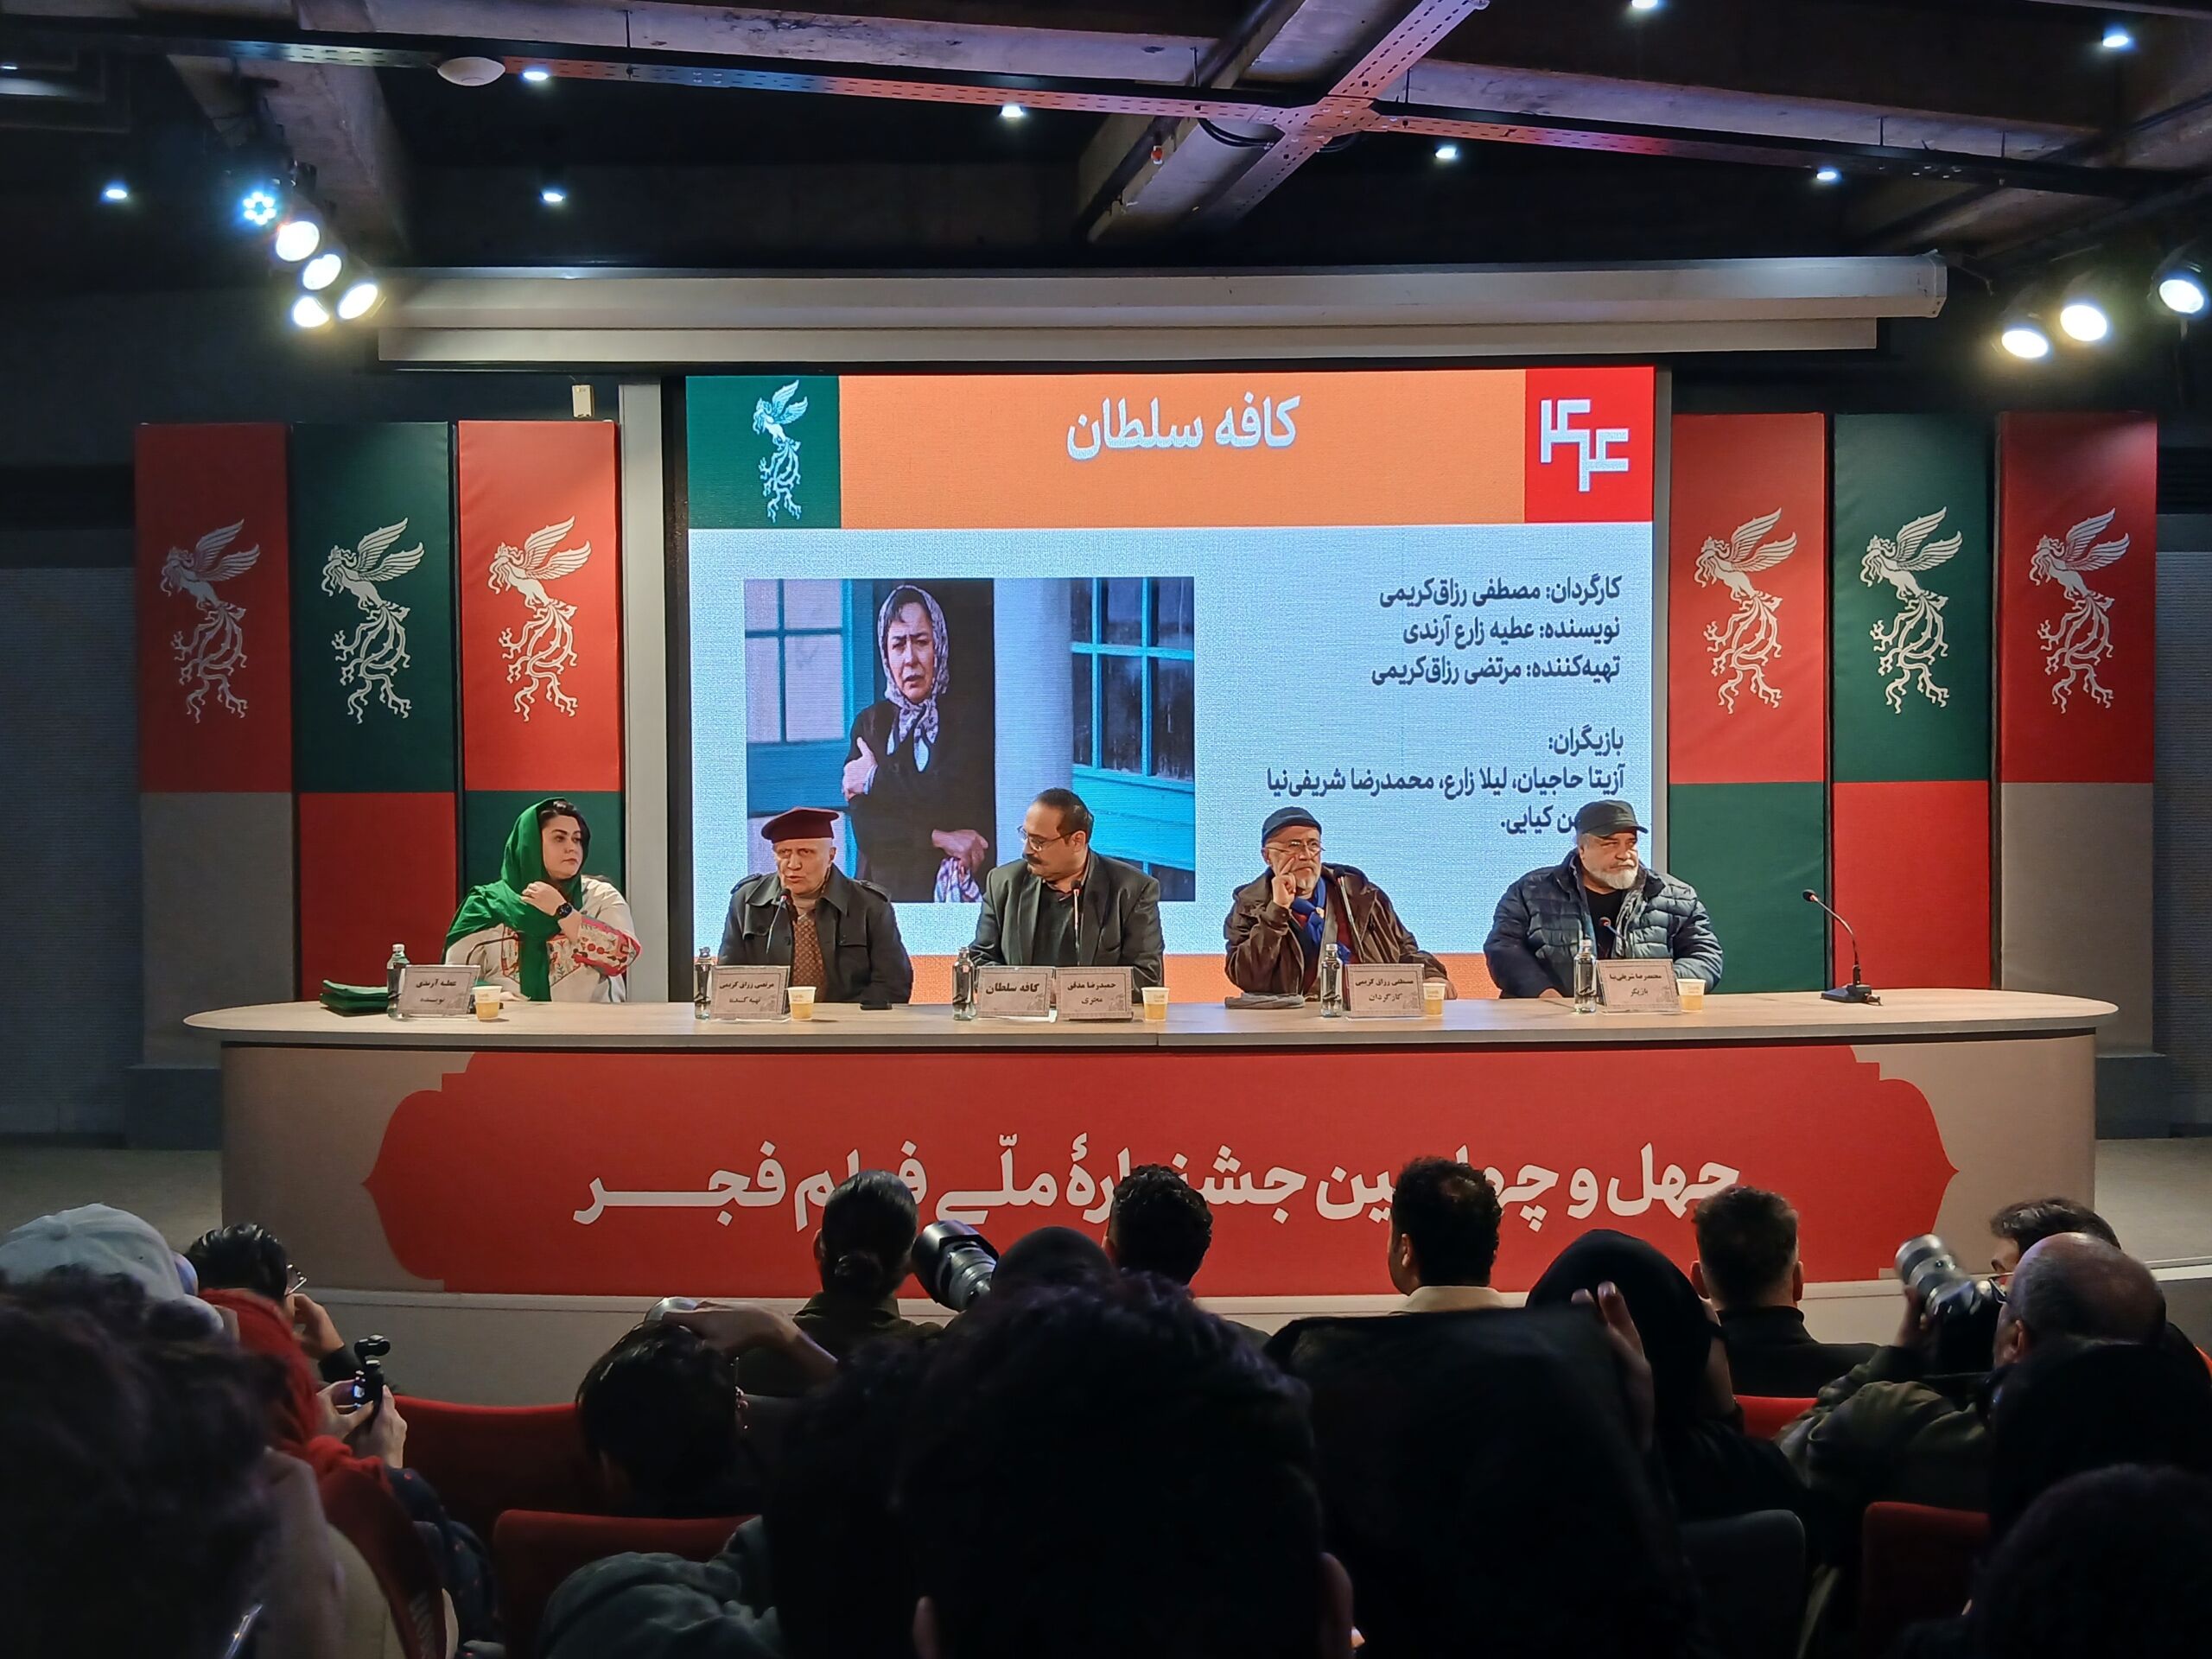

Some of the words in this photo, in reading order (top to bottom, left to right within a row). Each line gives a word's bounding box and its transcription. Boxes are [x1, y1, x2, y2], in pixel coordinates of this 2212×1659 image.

[1066, 397, 1205, 462] سلطان
[1214, 391, 1301, 450] کافه
[1472, 576, 1541, 607] مصطفی
[1546, 573, 1623, 607] کارگردان:
[1403, 613, 1452, 647] آرندی
[1454, 616, 1485, 650] زارع
[1490, 615, 1535, 645] عطیه
[1539, 616, 1620, 645] نویسنده:
[1464, 656, 1522, 685] مرتضی
[1548, 724, 1624, 757] بازیگران:
[1351, 767, 1434, 798] محمدرضا
[1439, 766, 1475, 801] زارع،
[1478, 766, 1507, 797] لیلا
[1512, 766, 1584, 797] حاجیان،
[1588, 763, 1626, 797] آزیتا
[1500, 804, 1554, 835] کیایی.
[985, 982, 1017, 995] سلطان
[1020, 982, 1039, 992] کافه
[573, 1141, 786, 1226] فجر
[1567, 1167, 1599, 1219] و
